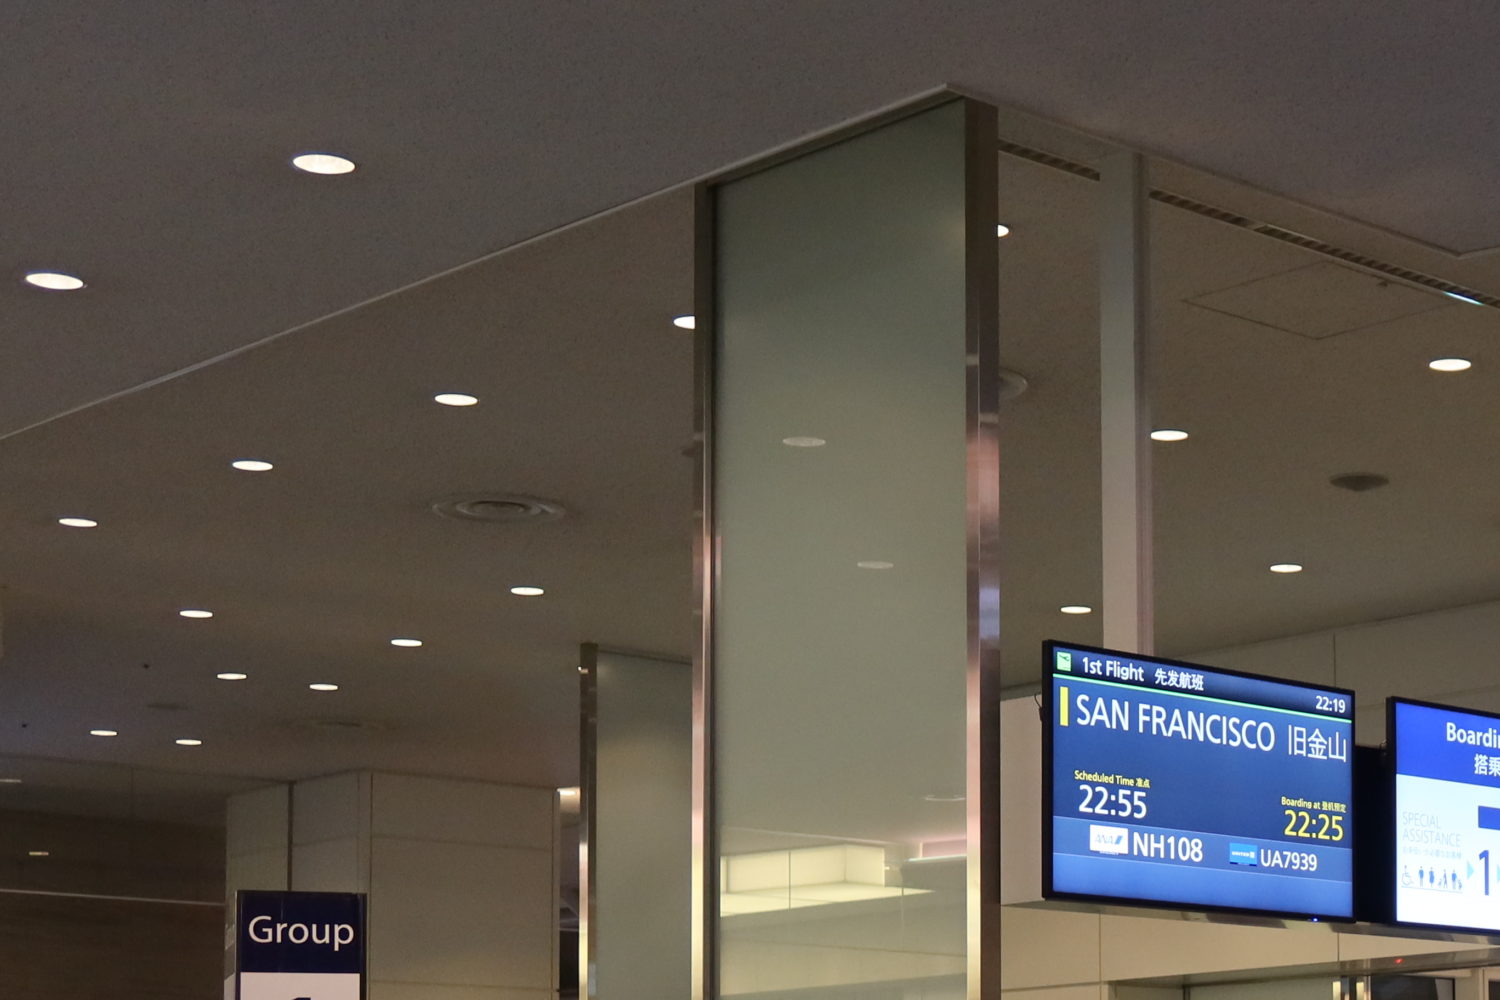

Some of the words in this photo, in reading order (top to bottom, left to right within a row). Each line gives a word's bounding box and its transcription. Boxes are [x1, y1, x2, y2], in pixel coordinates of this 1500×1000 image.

[1082, 656, 1102, 676] 1st
[1105, 660, 1145, 682] Flight
[1154, 667, 1205, 691] 先发航班
[1315, 694, 1347, 714] 22:19
[1076, 694, 1130, 732] SAN
[1138, 704, 1276, 752] FRANCISCO
[1287, 724, 1348, 763] 旧金山
[1074, 769, 1115, 784] Scheduled
[1115, 775, 1135, 786] Time
[1078, 783, 1148, 819] 22:55
[1281, 796, 1312, 809] Boarding
[1313, 802, 1321, 810] at
[1284, 809, 1344, 841] 22:25
[1402, 811, 1441, 829] SPECIAL
[1132, 831, 1204, 862] NH108
[1260, 848, 1318, 872] UA7939
[1402, 828, 1462, 848] ASSISTANCE
[1478, 849, 1490, 896] 1
[248, 914, 355, 952] Group
